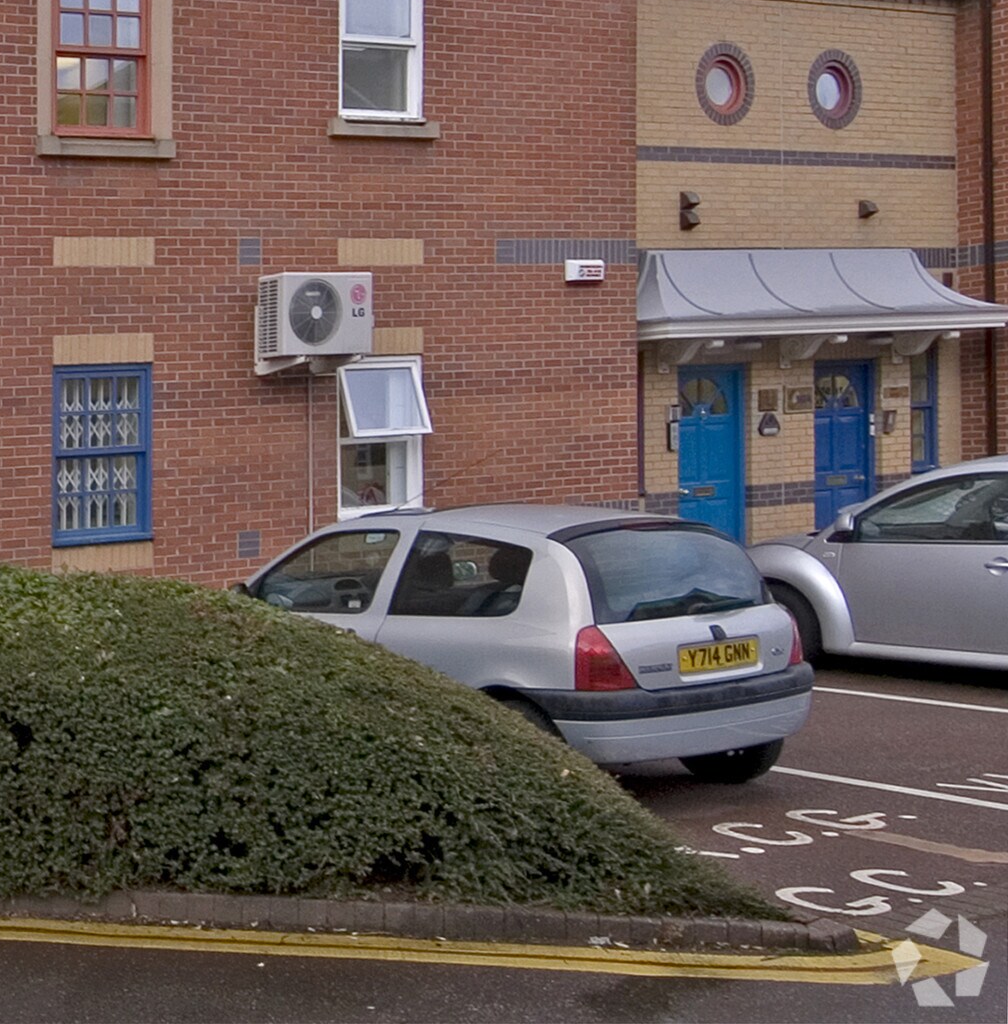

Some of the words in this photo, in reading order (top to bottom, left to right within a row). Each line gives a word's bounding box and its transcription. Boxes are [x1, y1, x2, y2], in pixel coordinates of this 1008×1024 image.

[352, 308, 365, 317] LG
[688, 647, 721, 668] Y714
[724, 643, 750, 663] GNN
